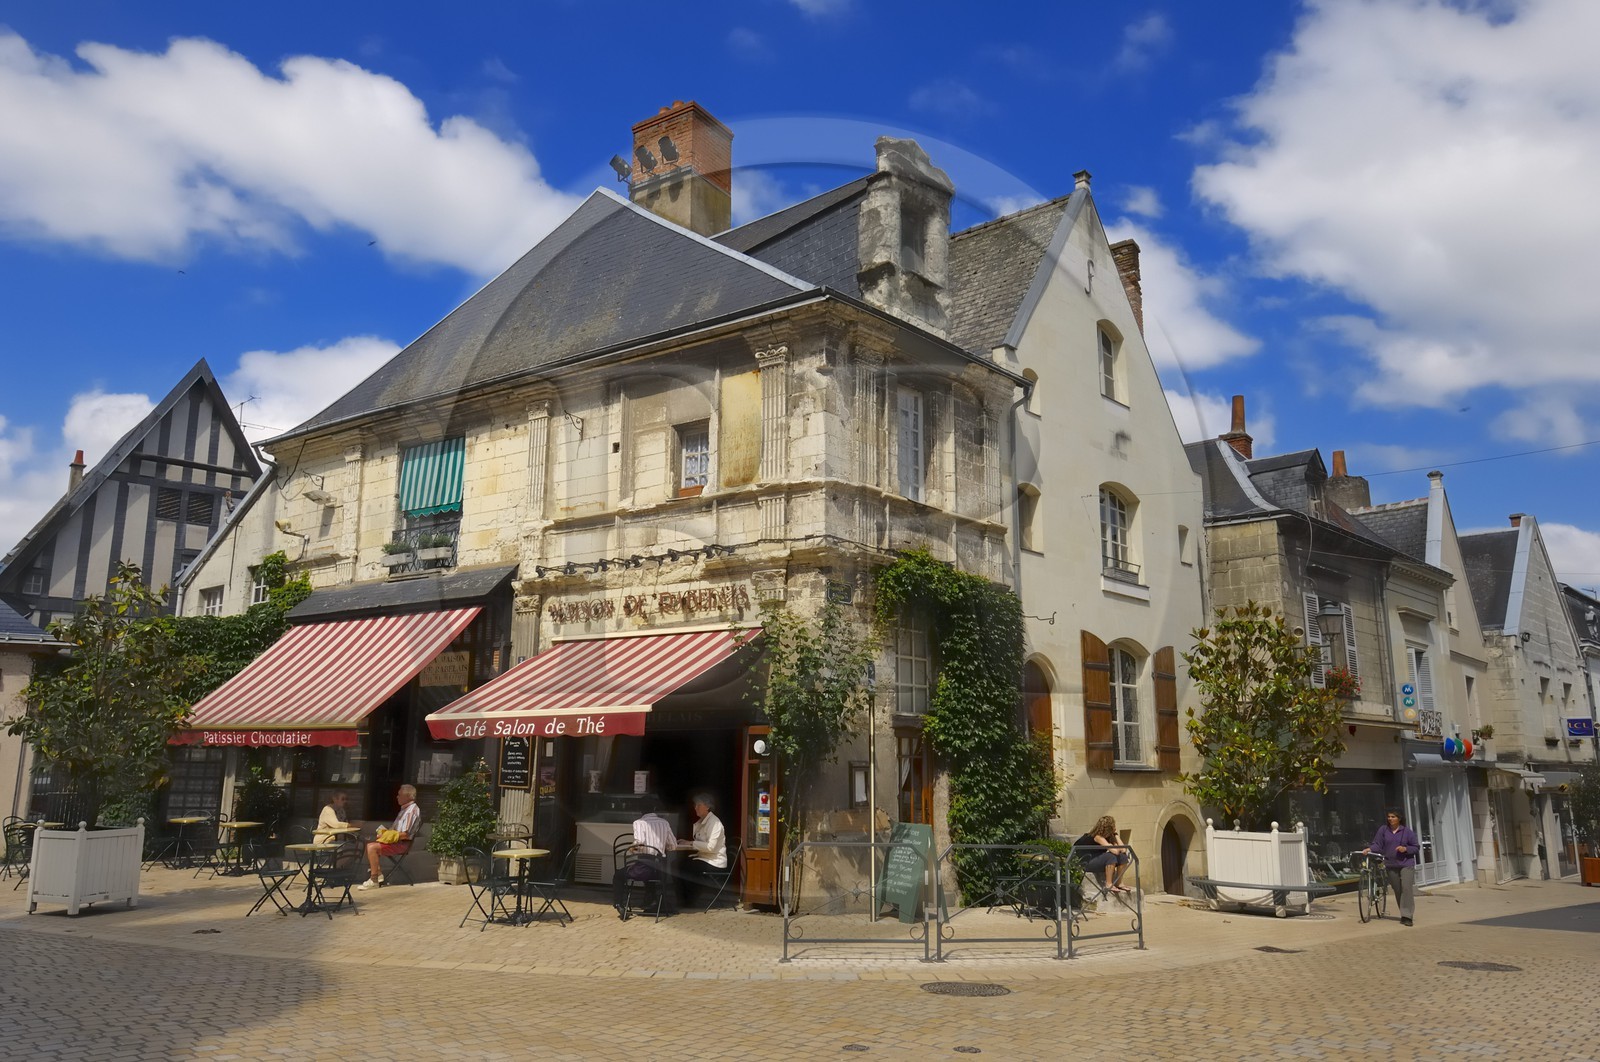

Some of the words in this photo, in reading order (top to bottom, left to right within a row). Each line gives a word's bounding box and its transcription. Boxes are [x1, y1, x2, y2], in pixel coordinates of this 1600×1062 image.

[623, 594, 647, 621] DE
[455, 721, 487, 737] Café
[493, 719, 535, 735] Salon
[544, 719, 565, 734] de
[576, 716, 605, 734] Thé
[203, 731, 246, 744] Patissier
[250, 731, 312, 744] Chocolatier
